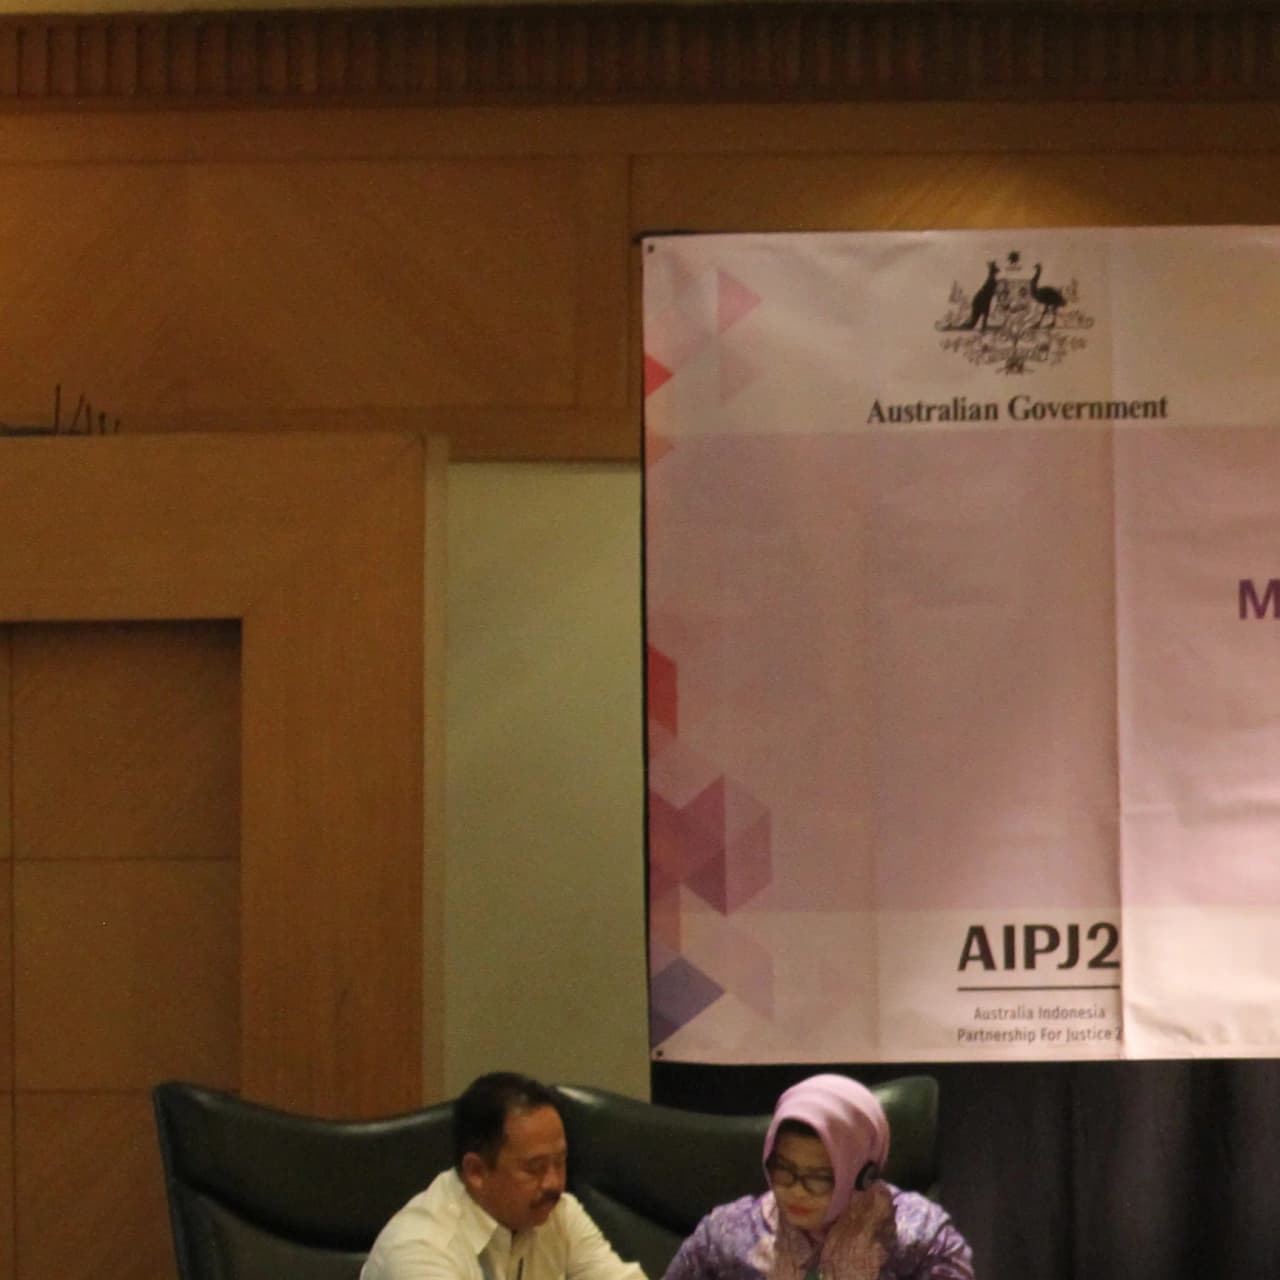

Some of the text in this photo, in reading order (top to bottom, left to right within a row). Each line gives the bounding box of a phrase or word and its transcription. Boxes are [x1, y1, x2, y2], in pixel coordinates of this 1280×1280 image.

[867, 396, 1167, 423] Australian Government
[957, 922, 1120, 971] AIPJ2
[974, 1003, 1106, 1021] Australia Indonesia
[957, 1027, 1036, 1044] Partnership
[1066, 1027, 1112, 1042] Justice
